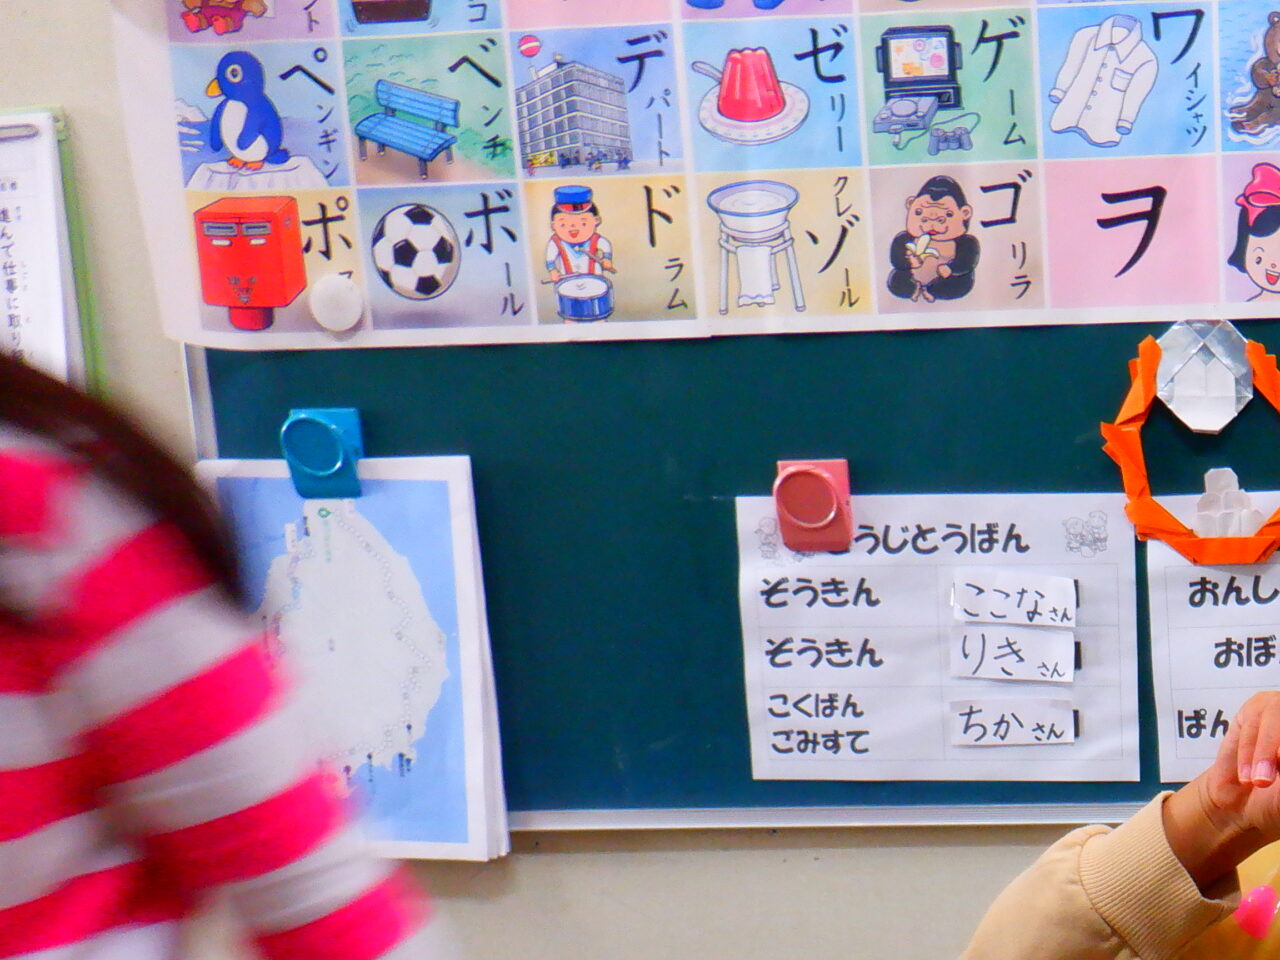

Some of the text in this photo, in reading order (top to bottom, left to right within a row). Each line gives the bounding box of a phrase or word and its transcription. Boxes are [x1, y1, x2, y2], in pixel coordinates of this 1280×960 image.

[279, 47, 339, 179] ペンギン
[448, 37, 506, 159] ベンチ
[617, 30, 671, 167] デパート
[794, 23, 848, 152] ゼリー
[971, 15, 1026, 145] ゲーム
[1152, 8, 1207, 148] ワイシャツ
[463, 188, 525, 317] ボール
[643, 184, 689, 310] ドラム
[806, 176, 861, 308] クレゾール
[980, 169, 1033, 299] ゴリラ
[1096, 185, 1168, 279] ヲ
[760, 576, 882, 608] ぞうきん
[849, 523, 1032, 556] うじとうばん
[764, 637, 884, 669] ぞうきん
[767, 693, 865, 718] こくばん
